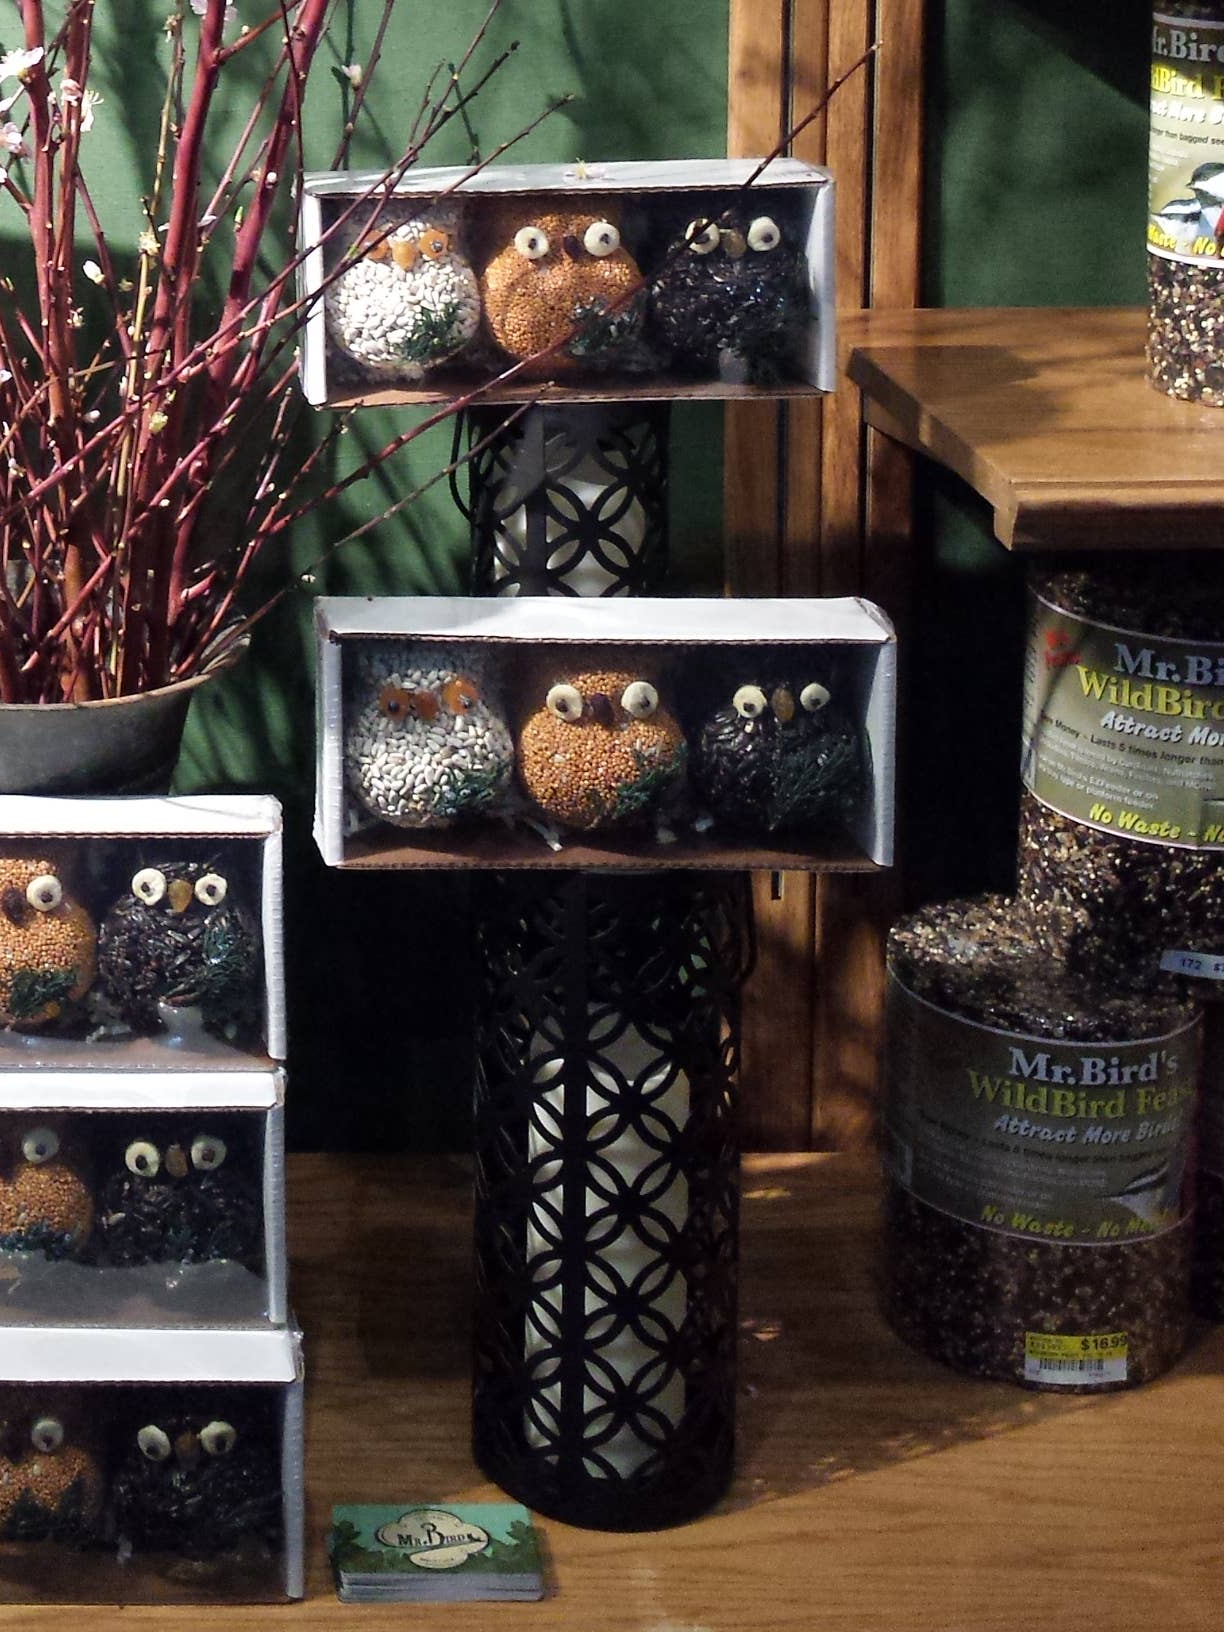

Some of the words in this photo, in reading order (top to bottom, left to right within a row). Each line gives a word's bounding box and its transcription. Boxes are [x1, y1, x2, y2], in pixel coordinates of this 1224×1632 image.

[1193, 235, 1216, 255] No
[1101, 710, 1182, 743] Attract
[1090, 734, 1116, 750] Lasts
[1128, 744, 1156, 759] times
[1160, 752, 1195, 765] longer
[1090, 803, 1113, 824] No
[1118, 811, 1181, 839] Waste
[969, 1070, 1127, 1120] WildBird
[994, 1113, 1077, 1144] Attract
[1080, 1124, 1130, 1145] More
[980, 1203, 1004, 1225] No
[1009, 1212, 1075, 1238] Waste
[1096, 1220, 1120, 1238] No
